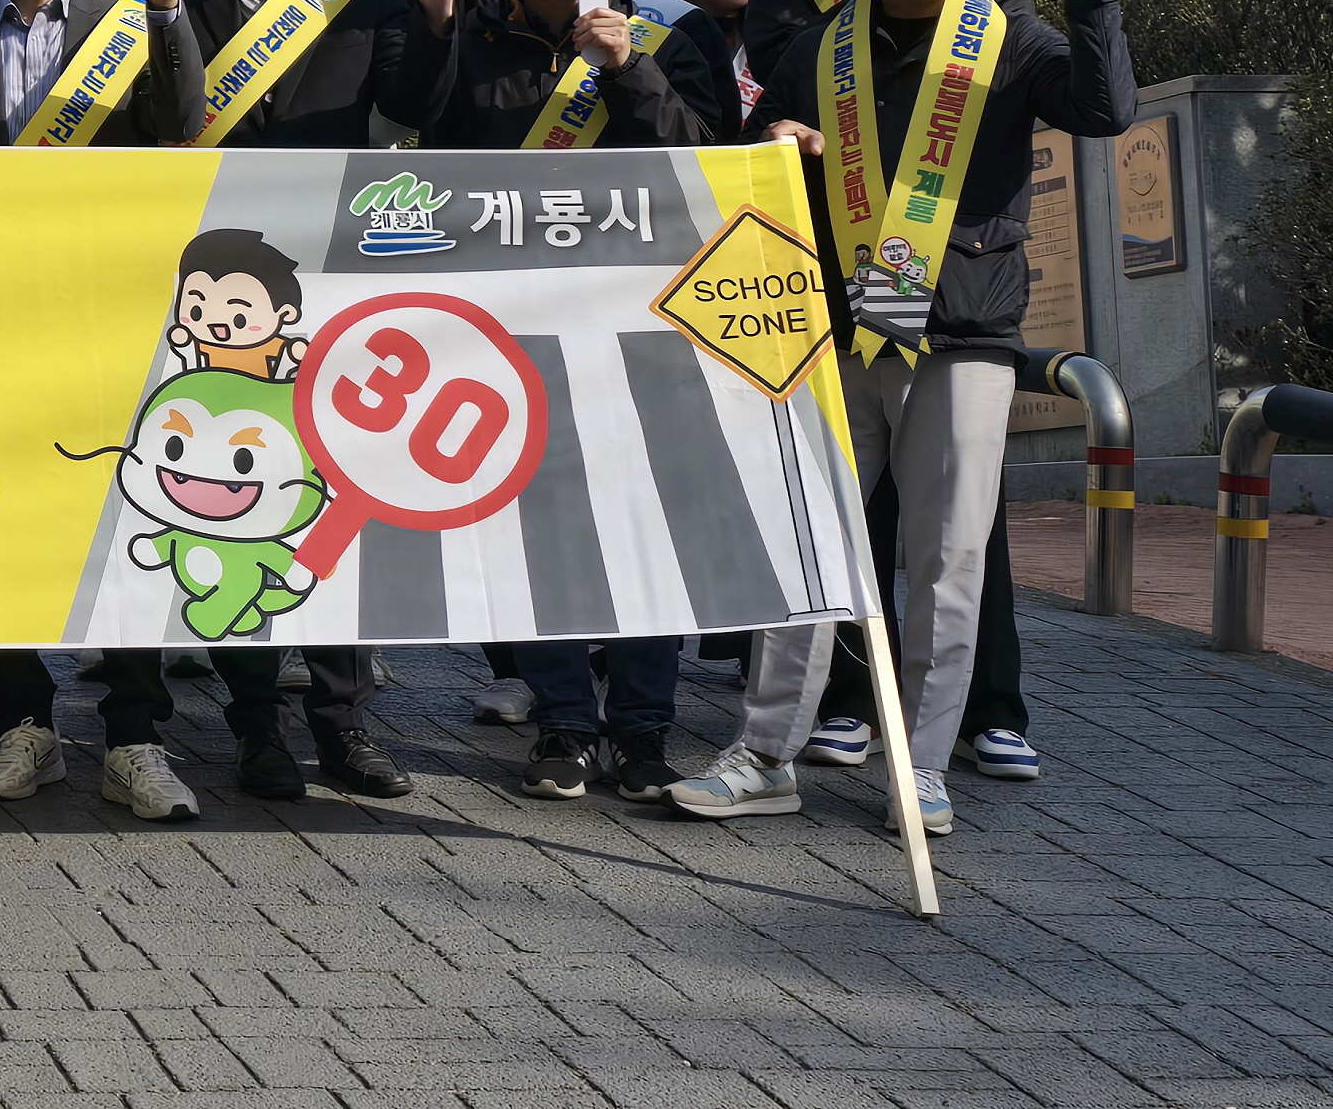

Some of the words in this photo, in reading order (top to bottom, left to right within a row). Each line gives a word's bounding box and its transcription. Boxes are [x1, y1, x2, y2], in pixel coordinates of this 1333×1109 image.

[919, 61, 975, 169] 행복도시
[371, 211, 432, 231] 계룡시
[467, 187, 654, 247] 계룡시
[904, 168, 944, 225] 계룡
[694, 269, 825, 303] SCHOOL
[718, 308, 808, 340] ZONE
[331, 327, 509, 484] 30
